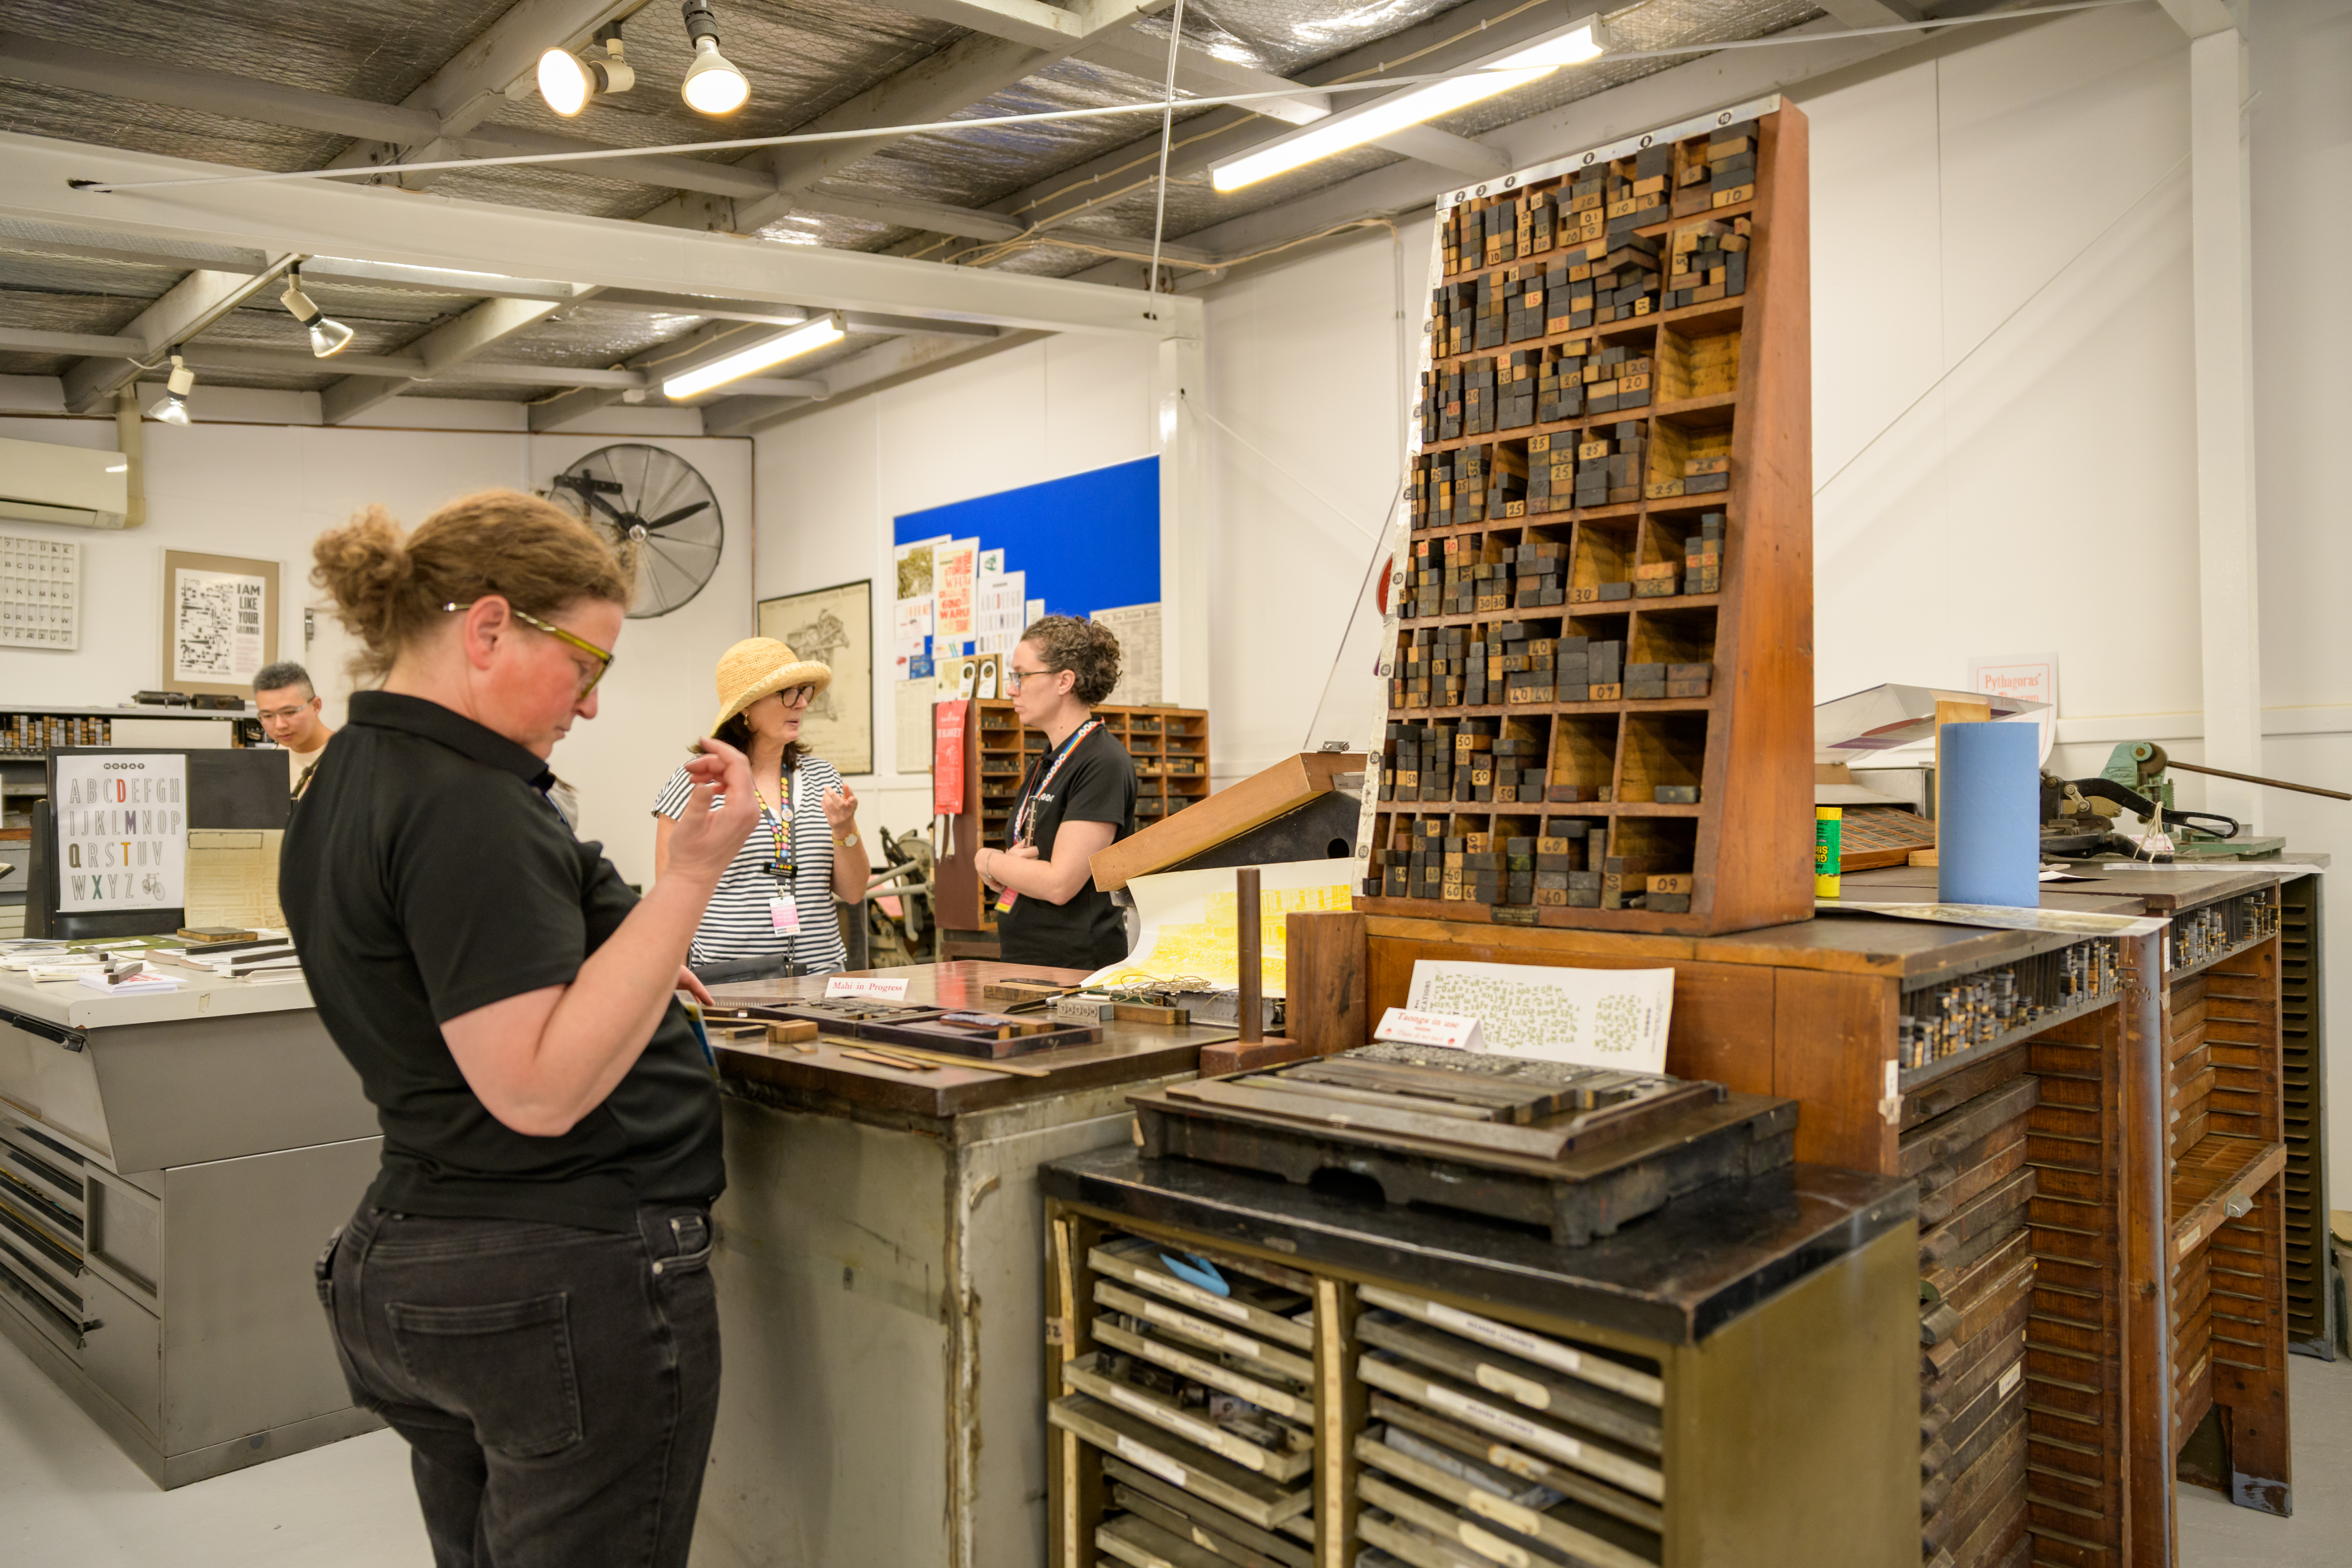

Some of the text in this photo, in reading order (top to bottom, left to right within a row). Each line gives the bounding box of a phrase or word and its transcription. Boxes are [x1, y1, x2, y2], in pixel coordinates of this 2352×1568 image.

[1726, 190, 1741, 203] 10
[1532, 198, 1541, 206] 10
[1581, 198, 1594, 207] 10
[1616, 203, 1628, 214] 10
[1566, 232, 1577, 243] 10
[1528, 294, 1538, 304] 15
[1554, 318, 1565, 330] 15
[1631, 362, 1646, 371] 20
[1626, 377, 1642, 389] 20
[1532, 438, 1544, 449] 25
[1587, 444, 1599, 456] 25
[1555, 465, 1568, 479] 25
[1656, 485, 1673, 495] 25
[1510, 503, 1521, 515] 25
[237, 584, 260, 595] I AM
[1576, 589, 1591, 601] 30
[239, 597, 257, 610] LIKE
[1479, 599, 1490, 608] 30
[1494, 597, 1504, 606] 30
[238, 611, 258, 624] YOUR
[236, 625, 259, 635] GRAMMAR
[1532, 641, 1547, 654] 40
[1512, 689, 1527, 701] 40
[1458, 737, 1470, 746] 50
[1408, 775, 1416, 783] 50
[1475, 772, 1488, 781] 50
[1501, 789, 1513, 799] 50
[1544, 841, 1559, 851] 60
[1396, 870, 1406, 878] 60
[1428, 871, 1438, 879] 60
[1447, 887, 1459, 896] 60
[1544, 892, 1560, 903] 60
[869, 983, 902, 993] Progress
[1397, 1012, 1428, 1024] Taonga
[1432, 1017, 1441, 1025] in
